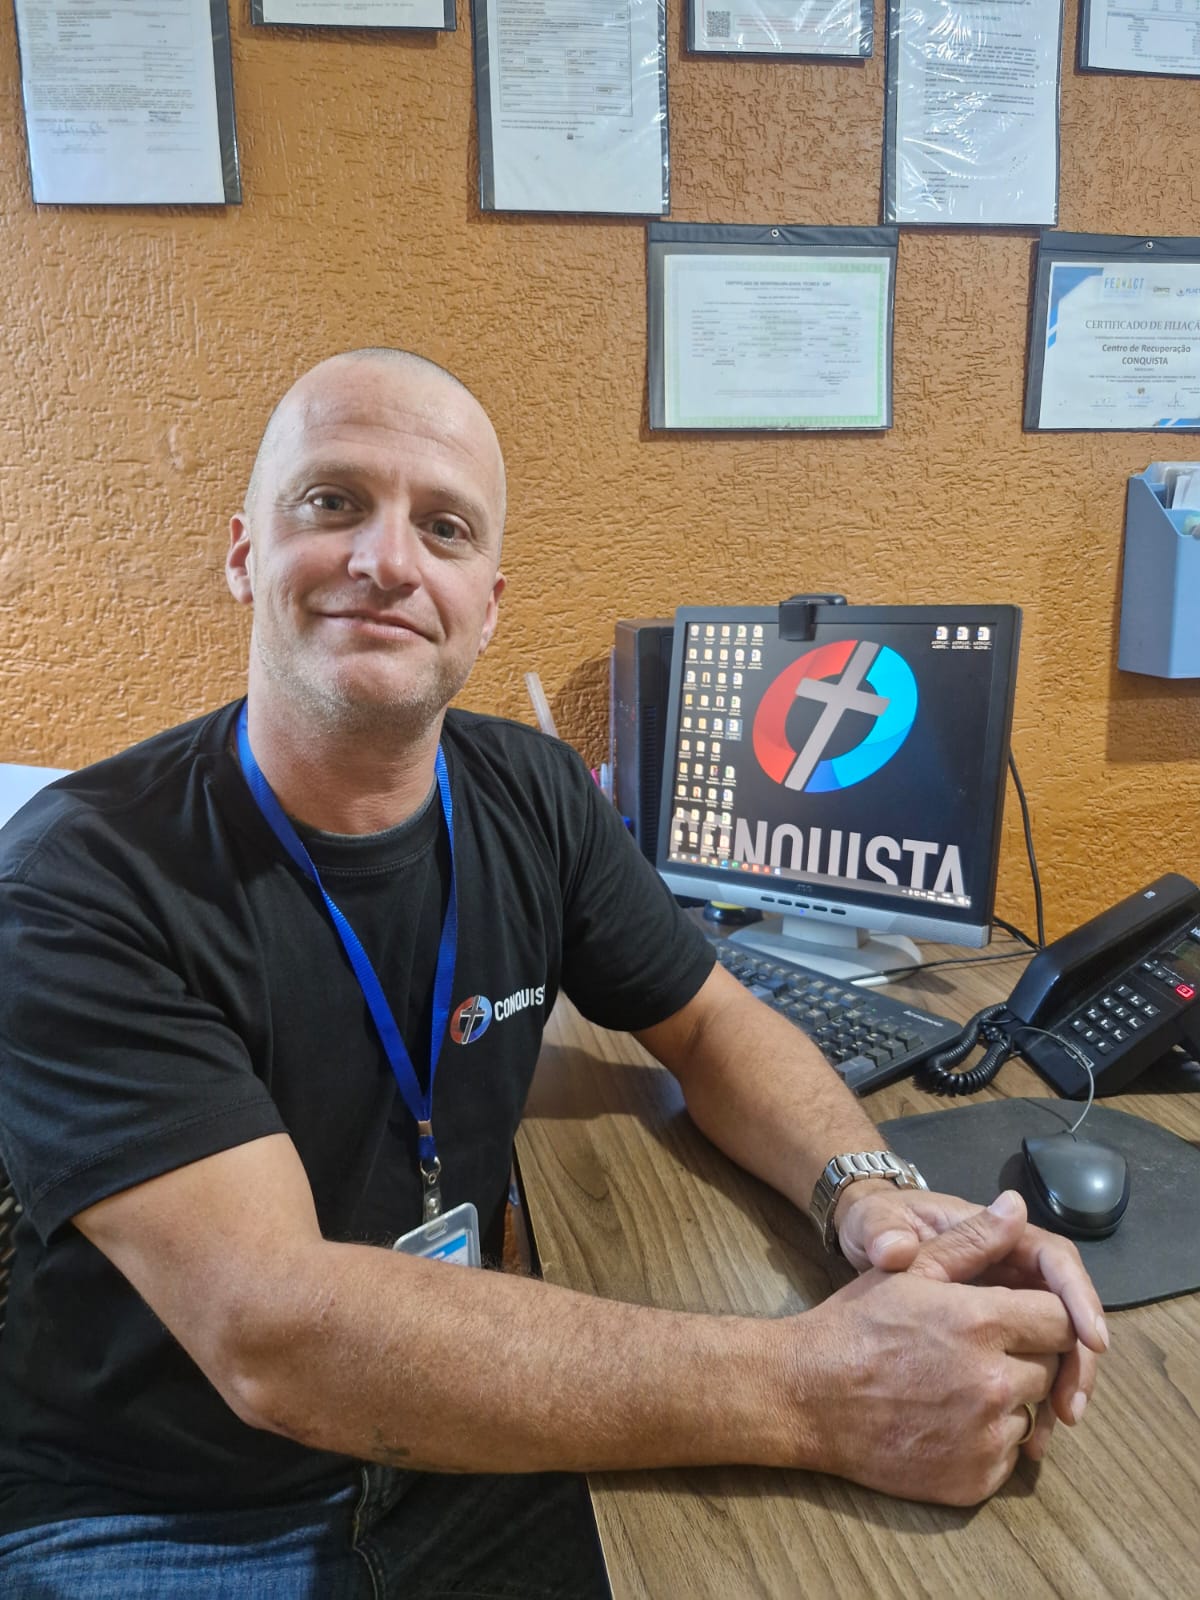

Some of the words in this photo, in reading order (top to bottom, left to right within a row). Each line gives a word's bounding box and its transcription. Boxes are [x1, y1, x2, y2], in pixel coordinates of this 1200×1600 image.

[1085, 319, 1148, 330] CERTIFICADO
[1149, 320, 1163, 330] DE
[1102, 344, 1128, 353] Centro
[1129, 344, 1140, 353] de
[1141, 344, 1191, 354] Recuperação
[1121, 356, 1169, 366] CONQUISTA
[494, 983, 546, 1021] CONQUIS
